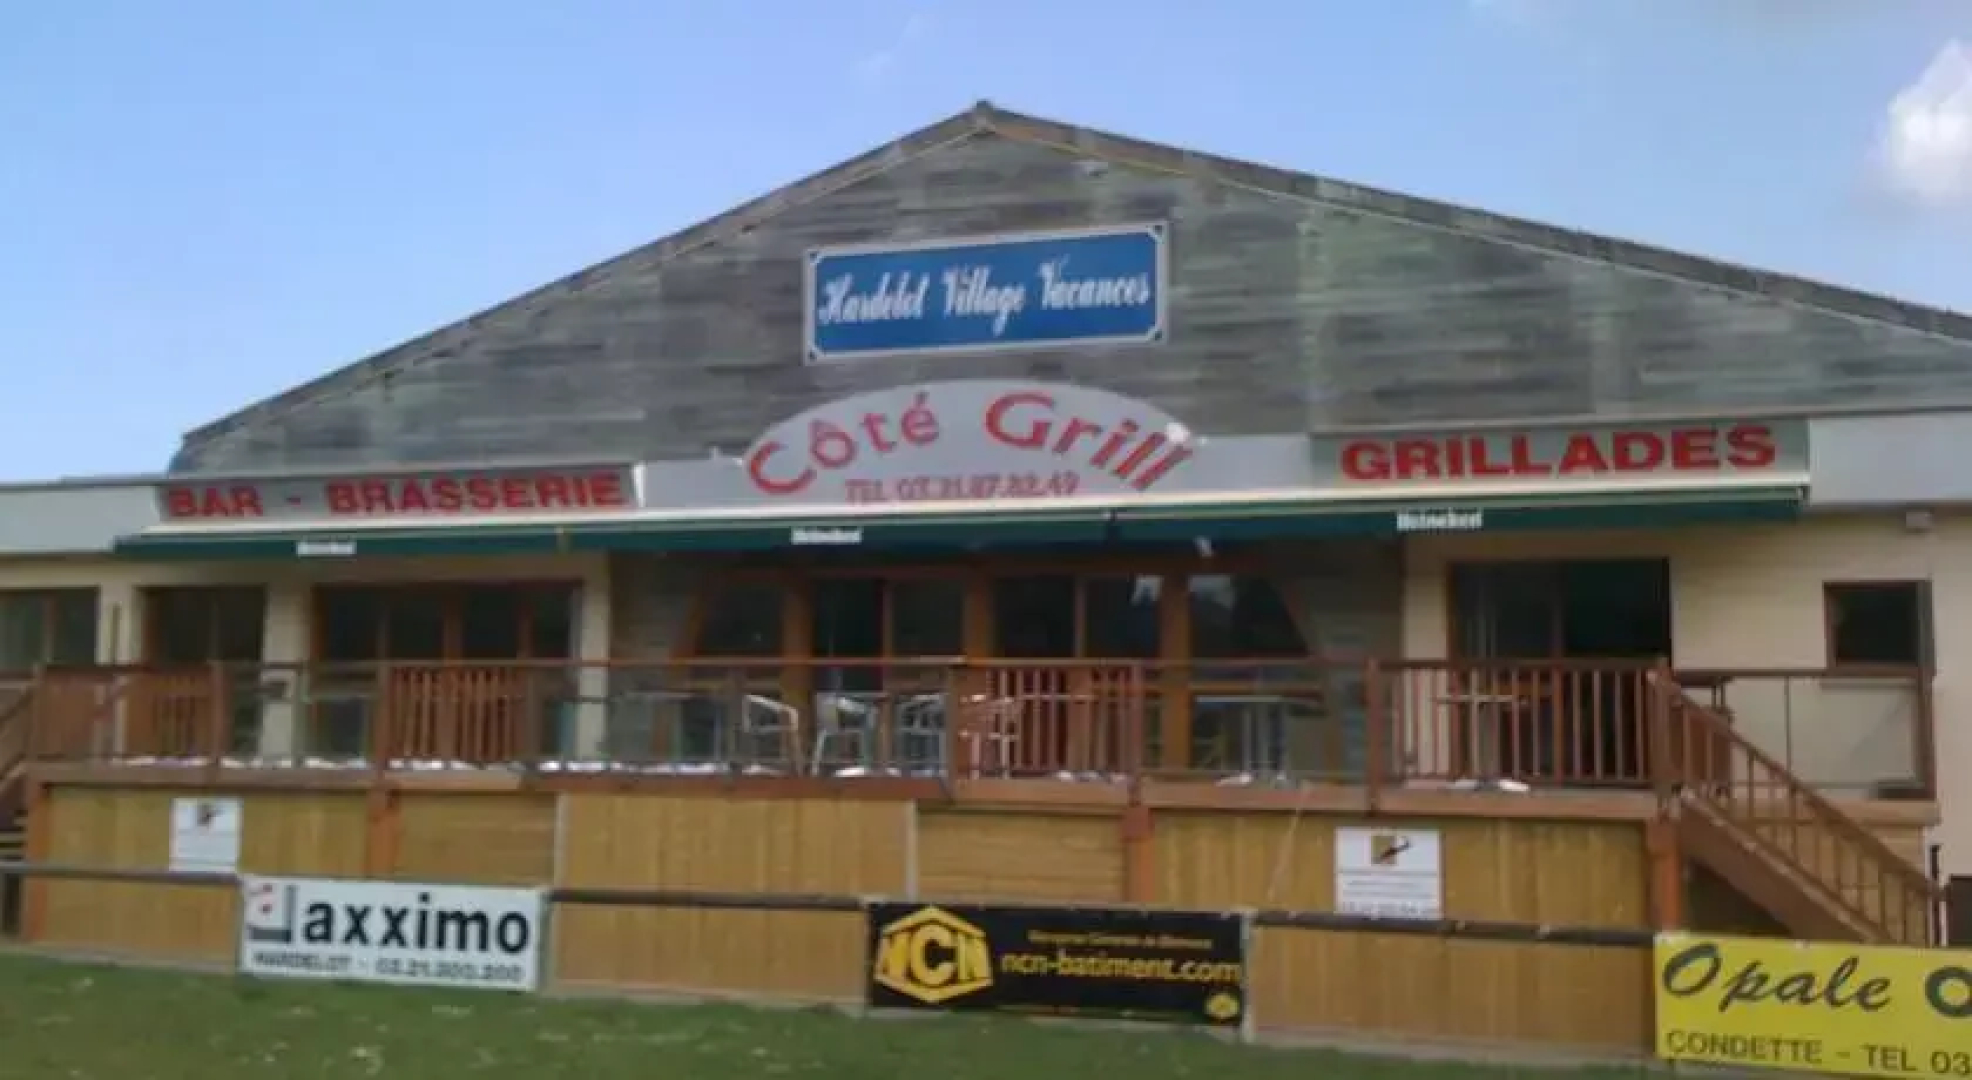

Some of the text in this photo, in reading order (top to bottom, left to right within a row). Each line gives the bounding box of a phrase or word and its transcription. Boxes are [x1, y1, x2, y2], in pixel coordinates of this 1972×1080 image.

[943, 263, 1026, 337] Village
[1037, 253, 1150, 309] Vacances
[748, 390, 1194, 495] Côté Grill
[1341, 425, 1776, 482] GRILLADES
[167, 484, 263, 518] BAR
[324, 470, 626, 515] BRASSERIE
[1662, 943, 1891, 1013] Opale
[1665, 1030, 1822, 1064] CONDETTE
[1860, 1043, 1916, 1071] TEL
